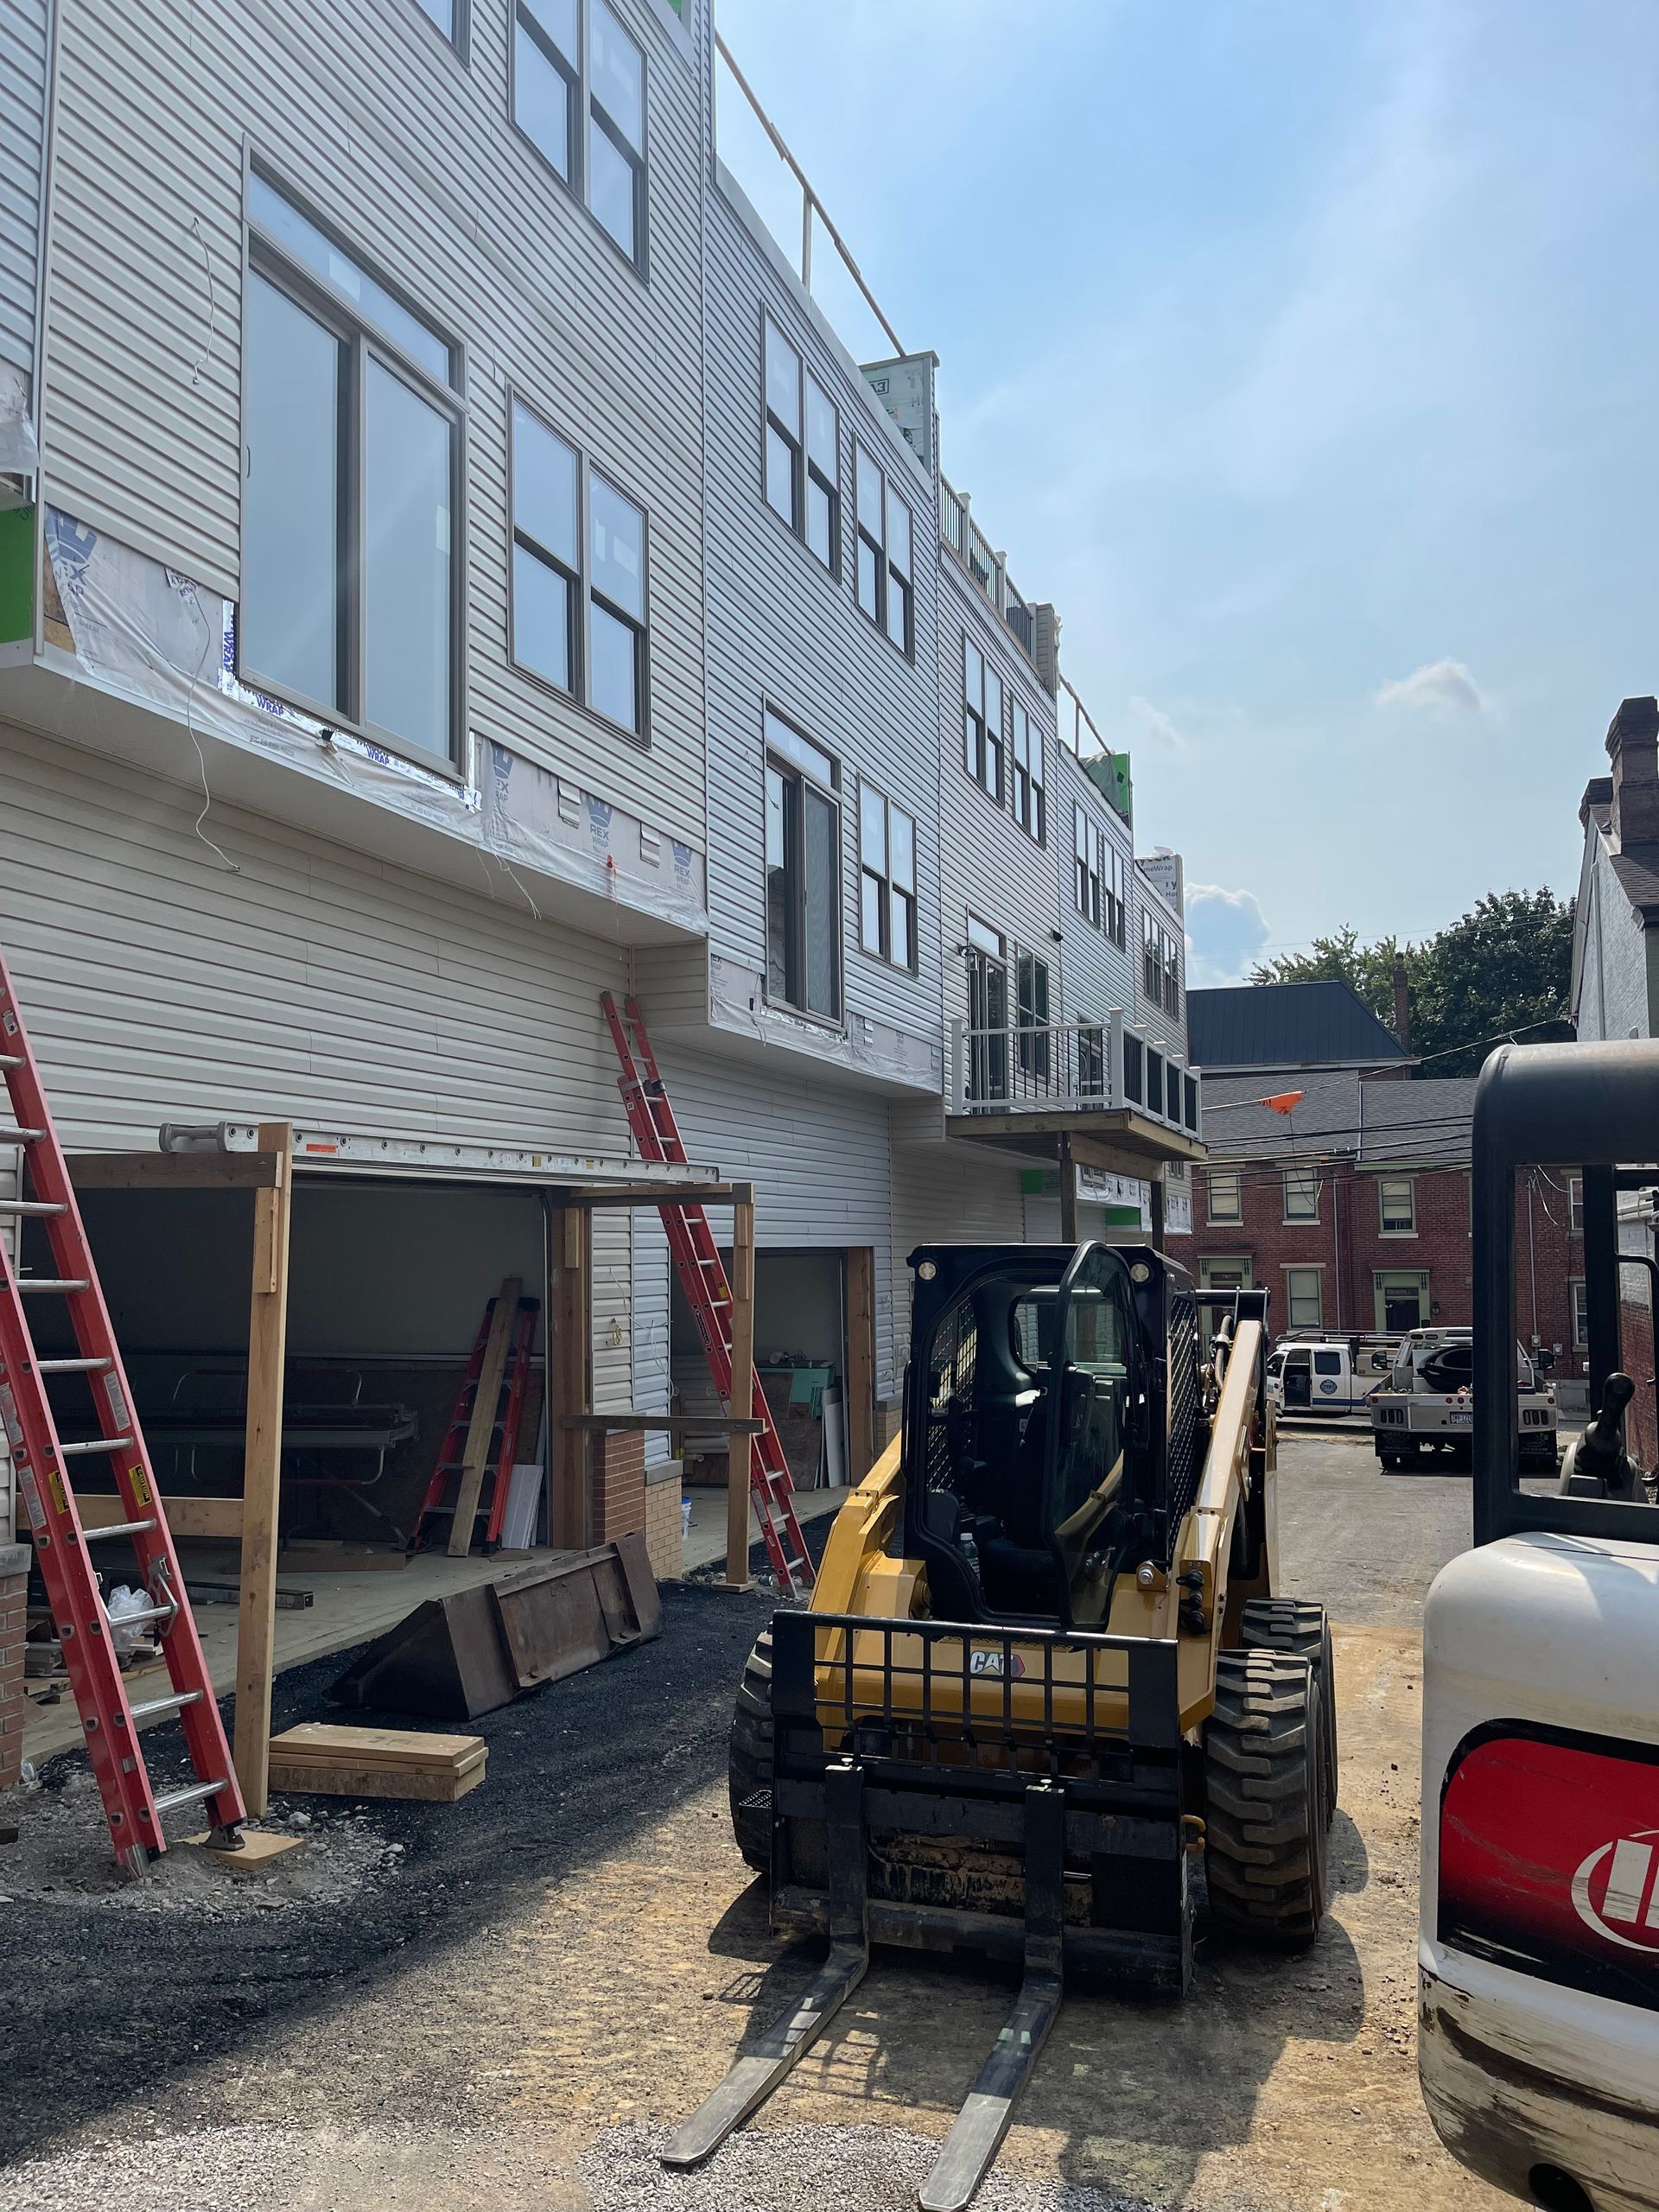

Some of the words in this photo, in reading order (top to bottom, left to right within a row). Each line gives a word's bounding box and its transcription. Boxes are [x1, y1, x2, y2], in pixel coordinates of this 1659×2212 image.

[223, 631, 235, 673] WRAP
[256, 695, 284, 716] WRAP
[366, 747, 390, 766] WRAP
[589, 823, 609, 842] REX
[593, 835, 608, 849] WRAP
[674, 863, 690, 878] REX
[677, 875, 690, 885] WRAP
[137, 1469, 150, 1499] CAUTION
[969, 1651, 1014, 1676] CAT
